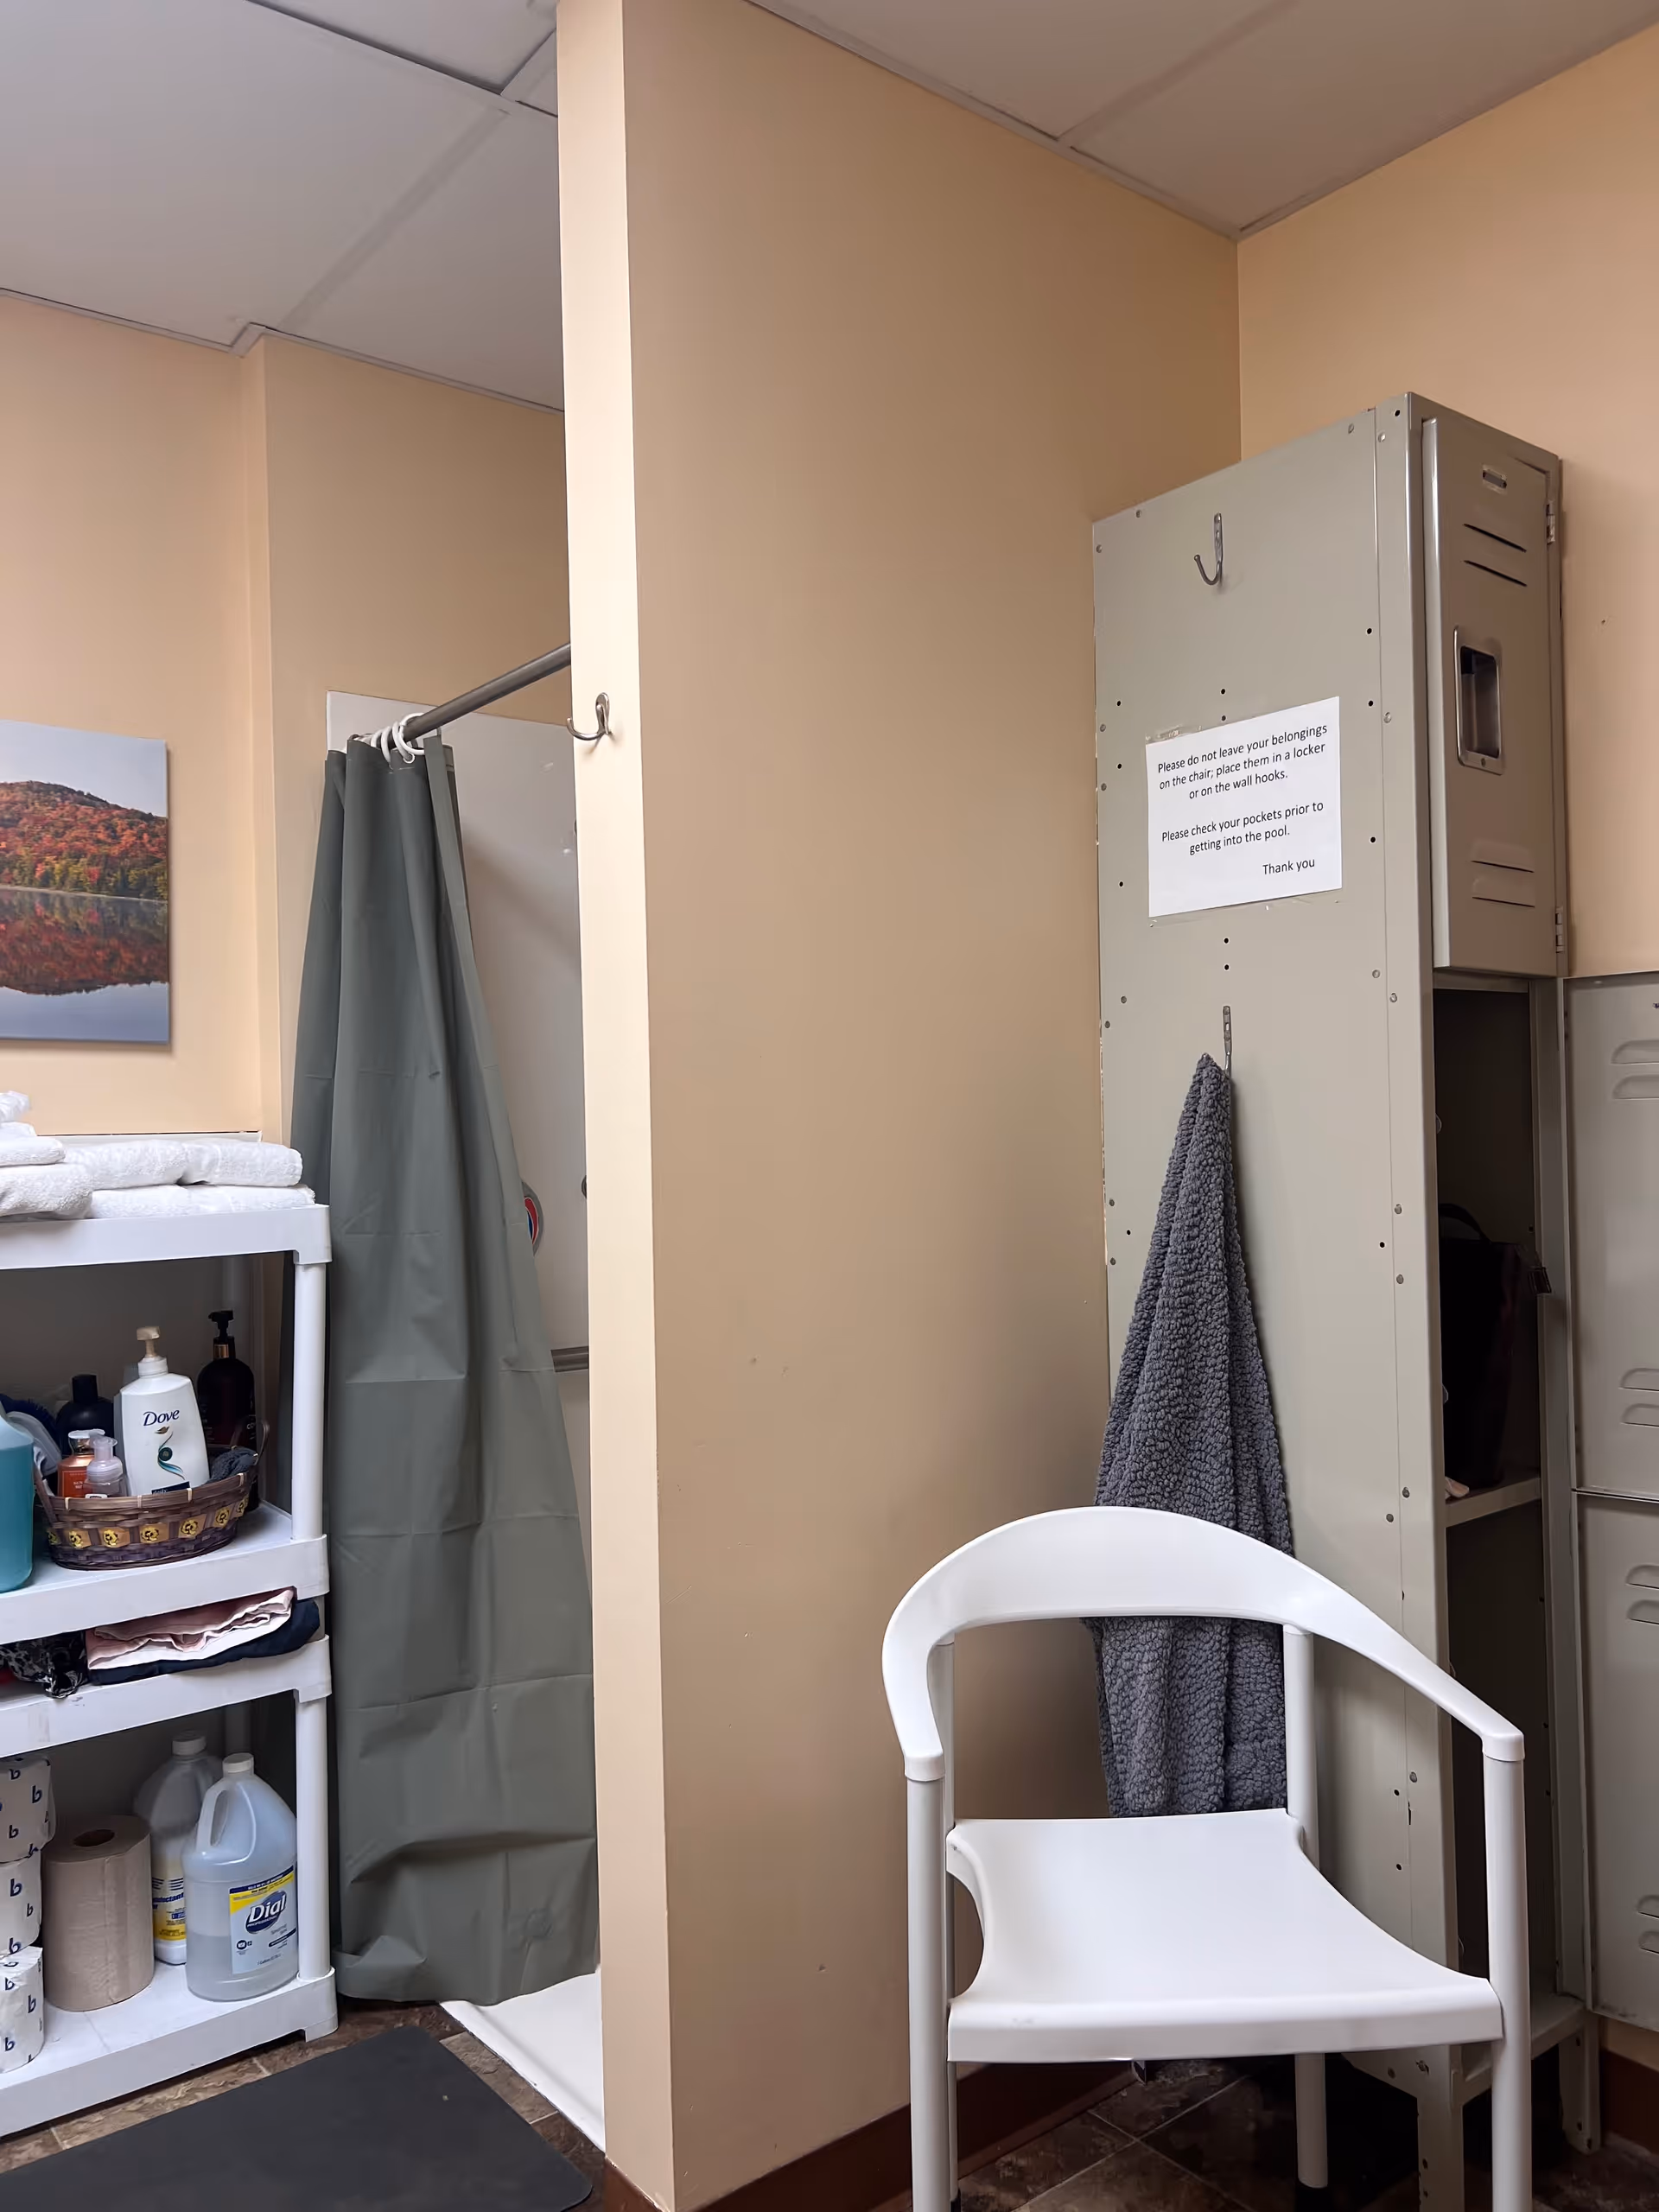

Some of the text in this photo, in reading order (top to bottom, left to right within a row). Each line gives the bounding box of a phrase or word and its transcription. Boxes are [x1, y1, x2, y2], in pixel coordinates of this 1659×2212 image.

[1158, 724, 1328, 773] Please do not leave your belongings
[1159, 741, 1326, 791] on the chair; place them in a locker
[1189, 771, 1289, 799] or on the wall hooks.
[1161, 800, 1324, 842] Please check your pockets prior to
[1189, 824, 1290, 856] getting into the pool.
[1262, 858, 1316, 875] Thank you
[143, 1409, 180, 1427] Dove
[247, 1893, 287, 1923] Dial
